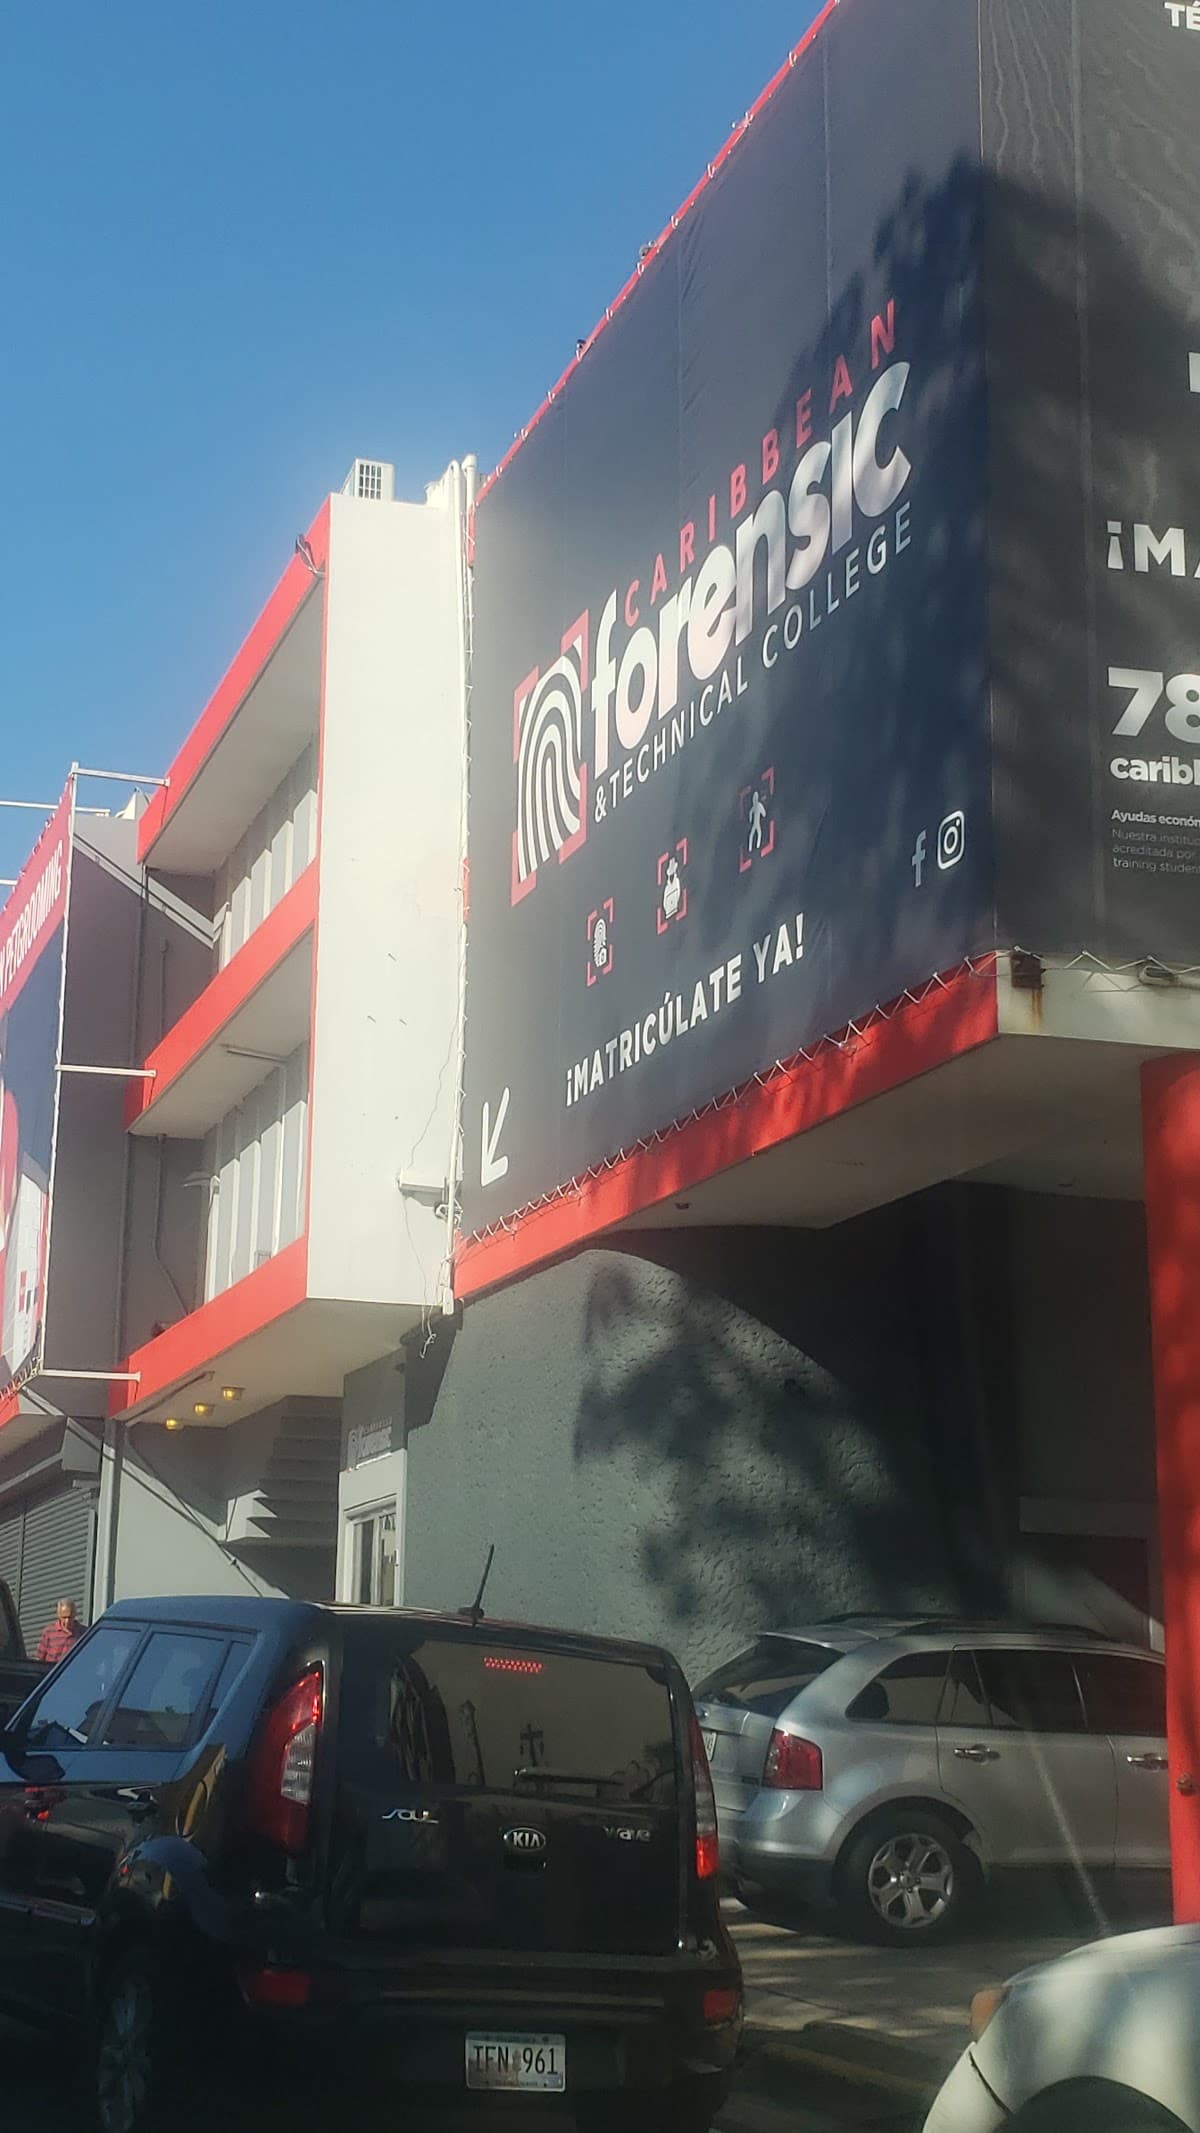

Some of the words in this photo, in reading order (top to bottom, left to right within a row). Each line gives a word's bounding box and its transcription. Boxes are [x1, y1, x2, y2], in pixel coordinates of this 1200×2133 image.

[624, 300, 895, 627] CARIBBEAN
[1107, 520, 1200, 577] ¡M
[761, 501, 911, 669] COLLEGE
[1111, 809, 1157, 824] Ayudas
[1112, 829, 1157, 842] Nuestra
[1113, 858, 1157, 872] training
[566, 952, 742, 1107] ¡MATRICÚLATE
[753, 912, 805, 983] YA!
[513, 1831, 541, 1848] KIA
[522, 2047, 558, 2075] 961
